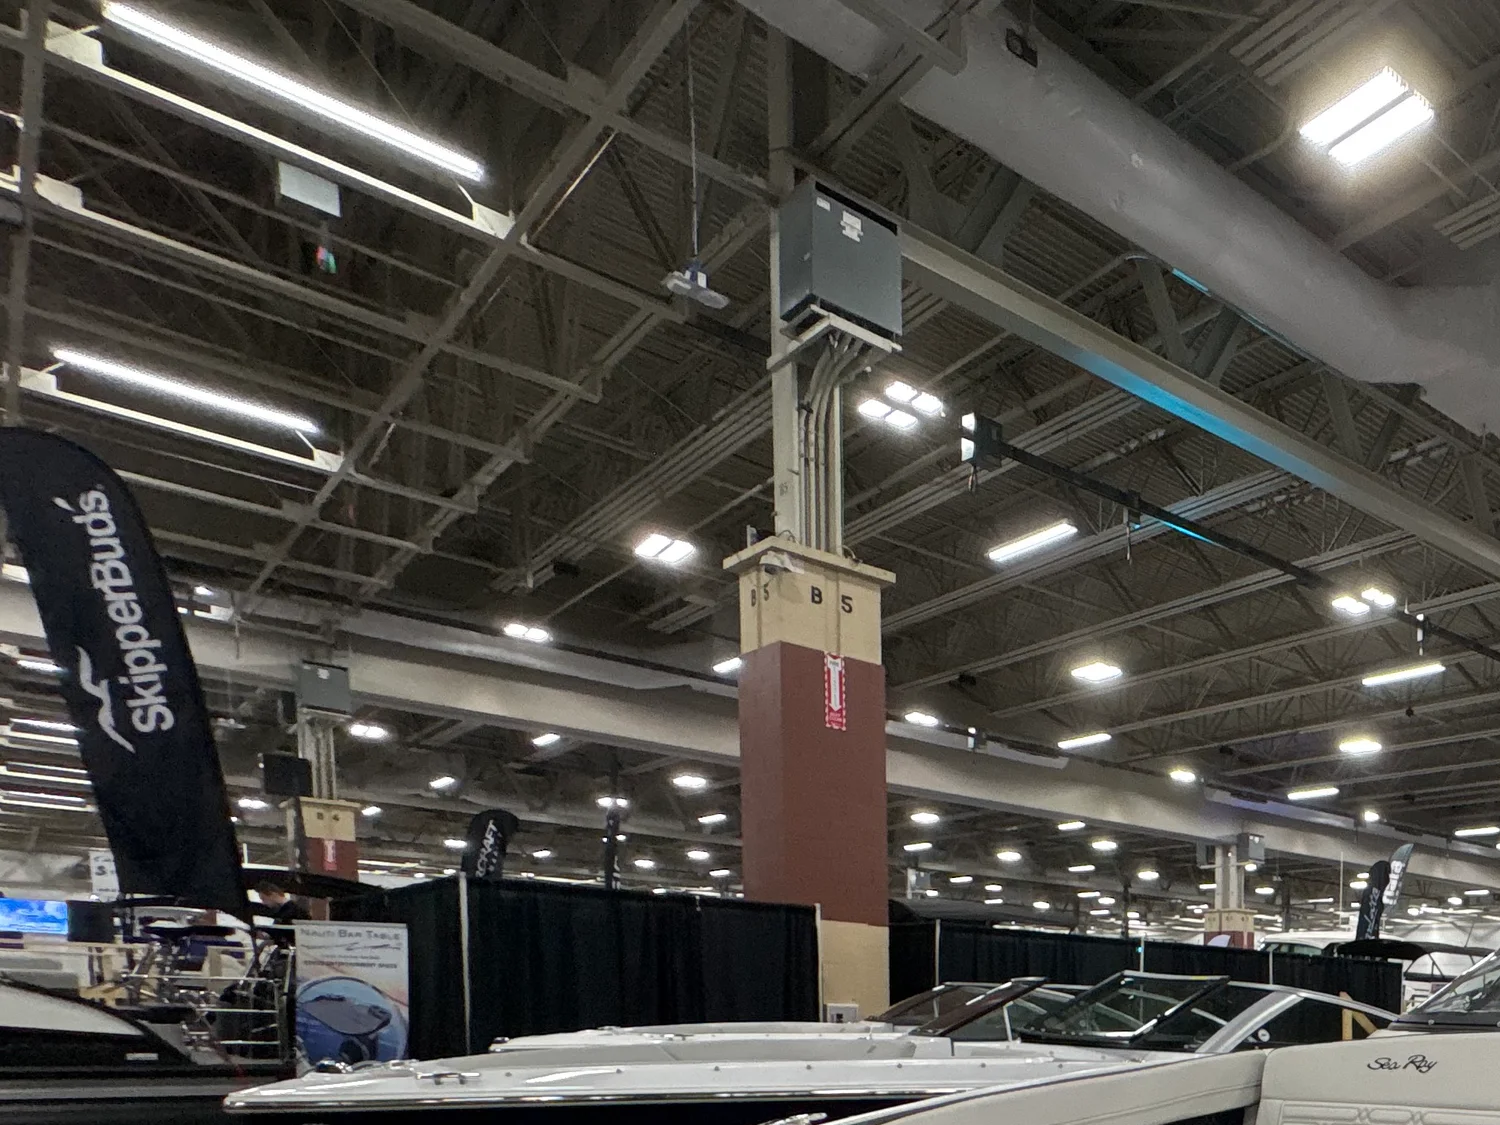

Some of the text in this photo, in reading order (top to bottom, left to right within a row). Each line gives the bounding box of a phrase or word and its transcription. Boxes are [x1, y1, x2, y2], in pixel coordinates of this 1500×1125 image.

[811, 585, 853, 613] B 5
[1367, 1054, 1437, 1073] Sea Ray
